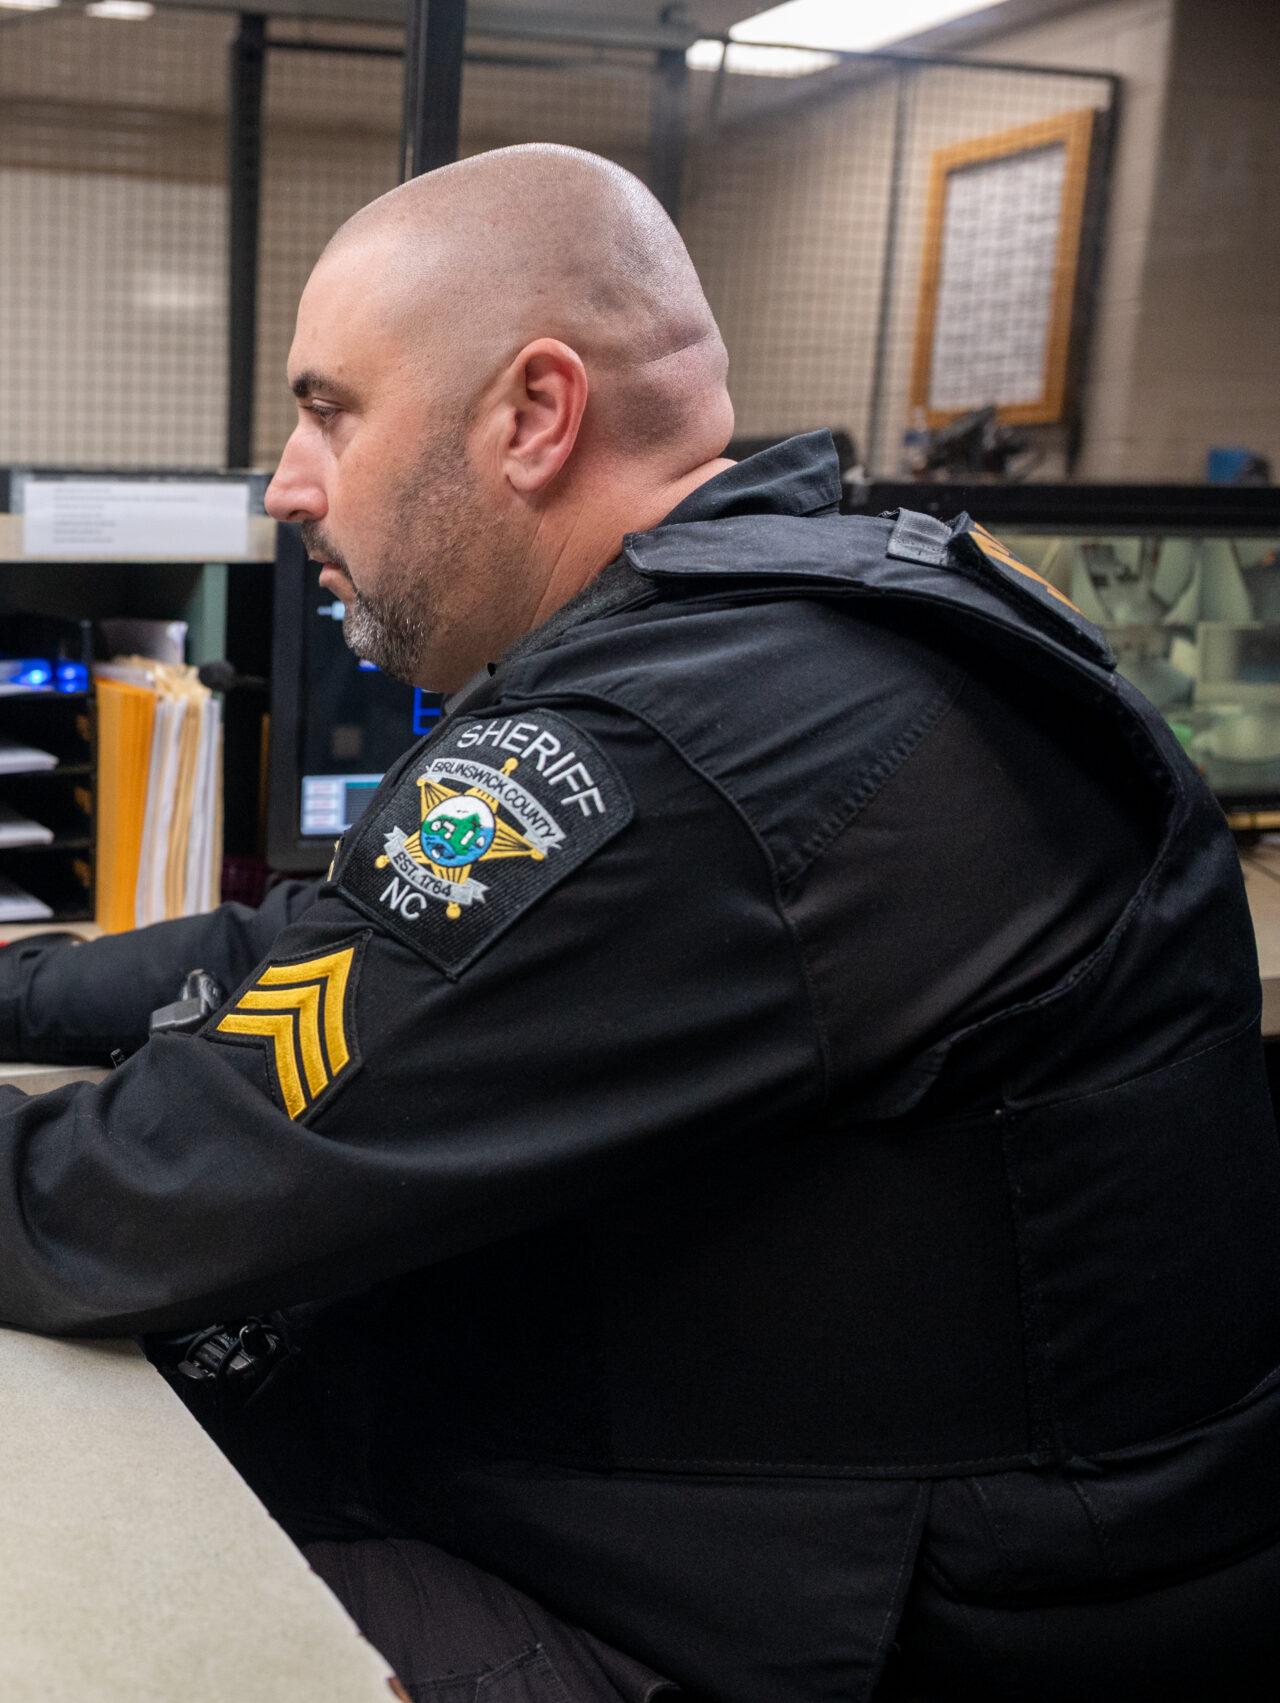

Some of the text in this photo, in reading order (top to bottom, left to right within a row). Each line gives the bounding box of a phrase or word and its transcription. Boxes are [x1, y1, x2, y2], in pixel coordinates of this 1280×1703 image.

[457, 719, 606, 817] SHERIFF
[432, 761, 556, 838] BRUNSWICK COUNTY
[379, 876, 427, 921] NC
[393, 853, 451, 897] EST. 1764
